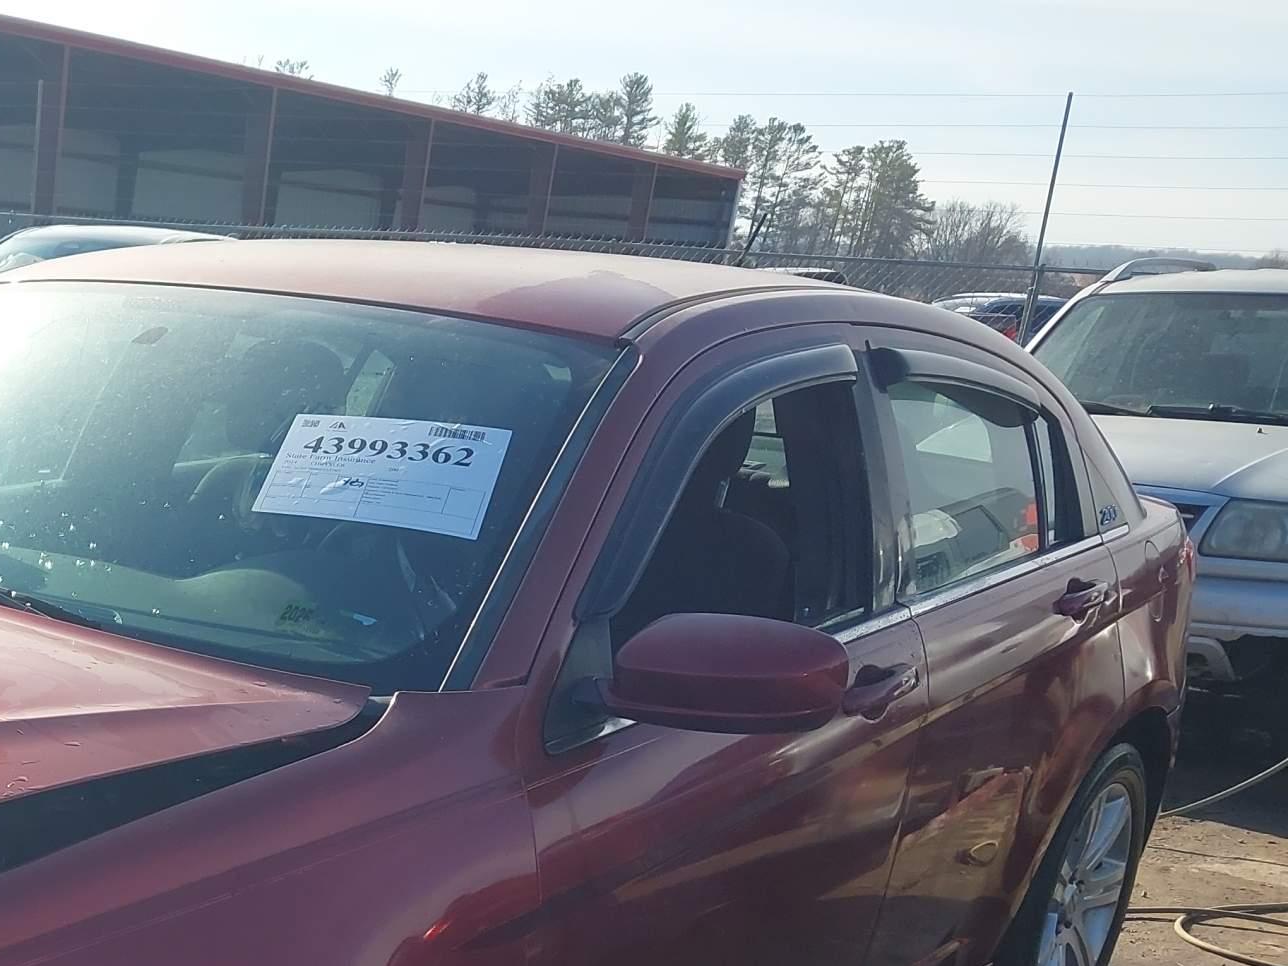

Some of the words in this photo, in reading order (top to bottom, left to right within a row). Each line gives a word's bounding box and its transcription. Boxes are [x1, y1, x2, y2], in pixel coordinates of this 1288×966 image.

[285, 452, 307, 460] State
[310, 454, 331, 462] Farm
[335, 455, 377, 465] Insurance
[303, 435, 474, 467] 43993362
